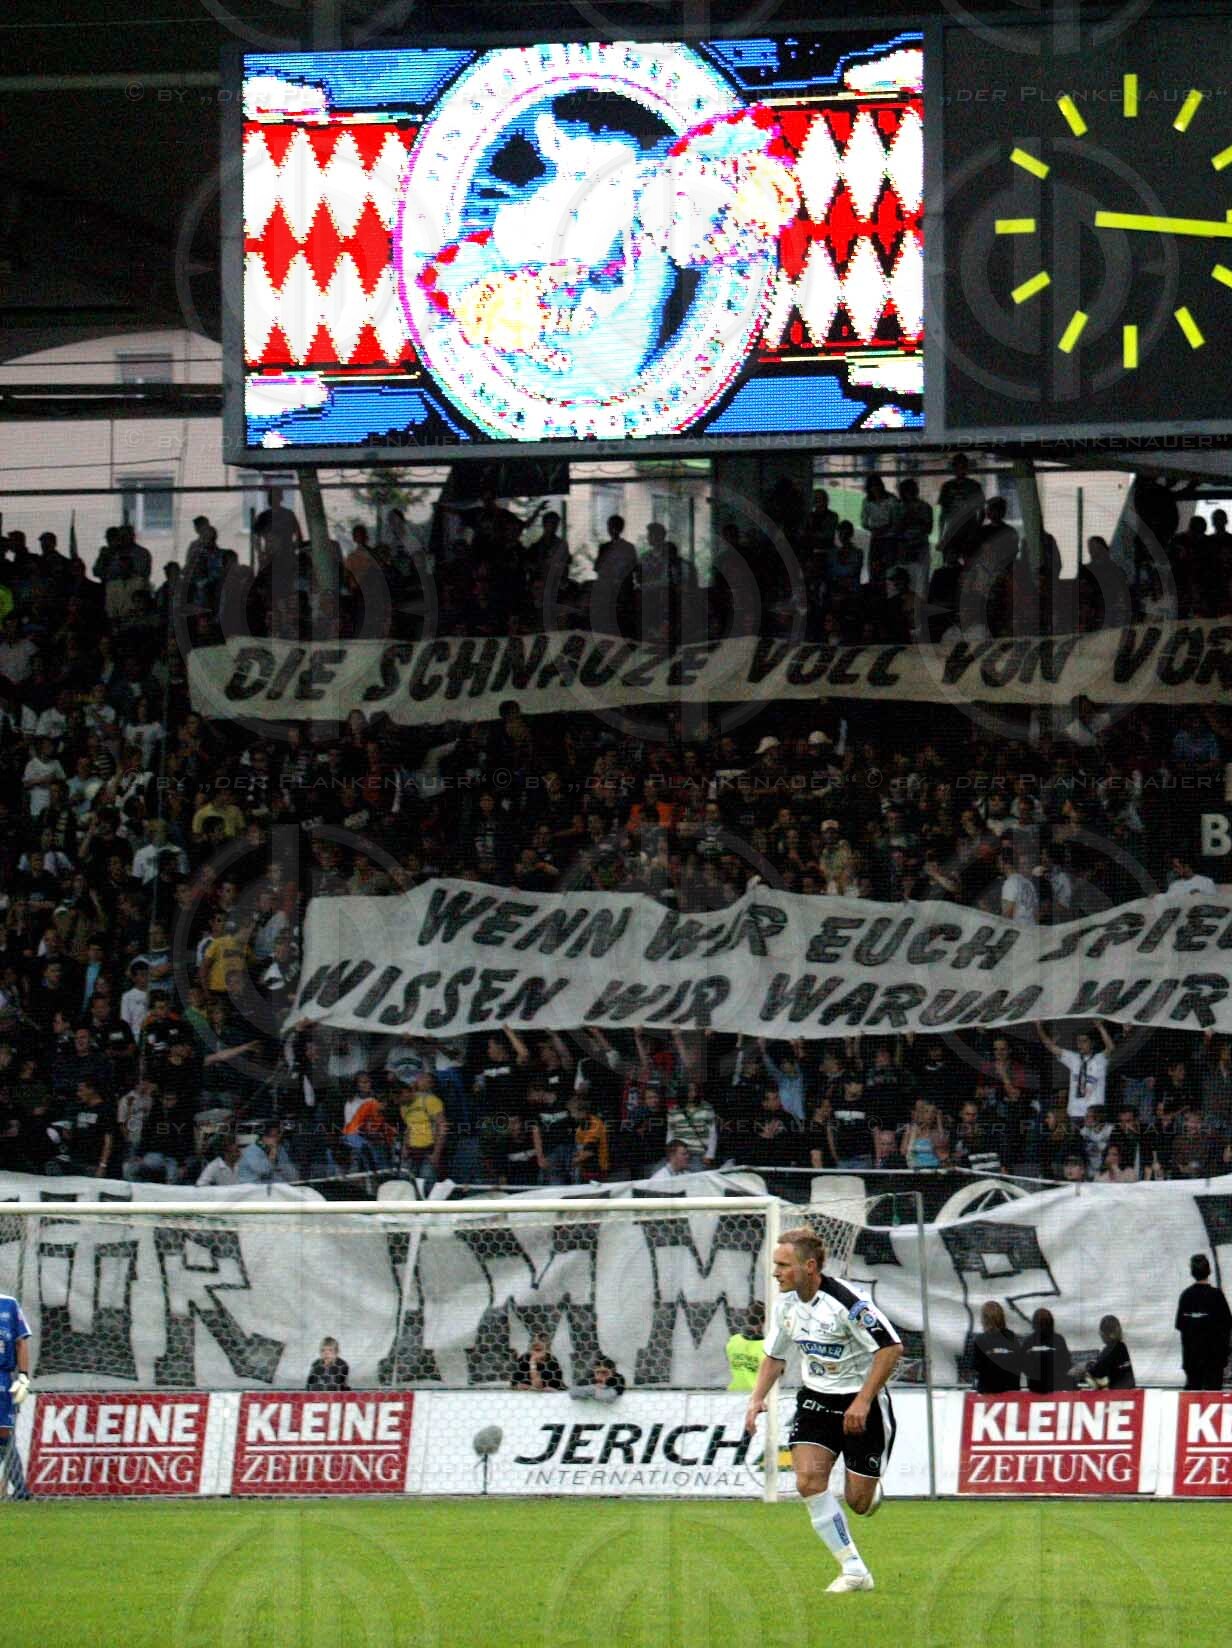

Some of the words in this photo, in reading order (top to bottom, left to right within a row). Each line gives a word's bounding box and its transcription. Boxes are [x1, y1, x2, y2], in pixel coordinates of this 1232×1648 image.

[224, 645, 347, 701] DIE
[363, 634, 719, 702] SCHNAUZE
[746, 637, 908, 688] VOLL
[941, 633, 1084, 690] VON
[416, 887, 635, 961] WENN
[645, 902, 790, 962] WIR
[805, 915, 1022, 972] EUCH
[300, 957, 570, 1032] WISSEN
[584, 975, 731, 1029] WIR
[757, 971, 1046, 1029] WARUM
[1069, 971, 1231, 1030] WIR
[42, 1404, 197, 1446] KLEINE
[242, 1400, 401, 1445] KLEINE
[970, 1401, 1135, 1443] KLEINE
[34, 1452, 196, 1486] ZEITUNG
[241, 1450, 400, 1485] ZEITUNG
[524, 1468, 746, 1487] INTERNATIONAL
[968, 1451, 1133, 1487] ZEITUNG
